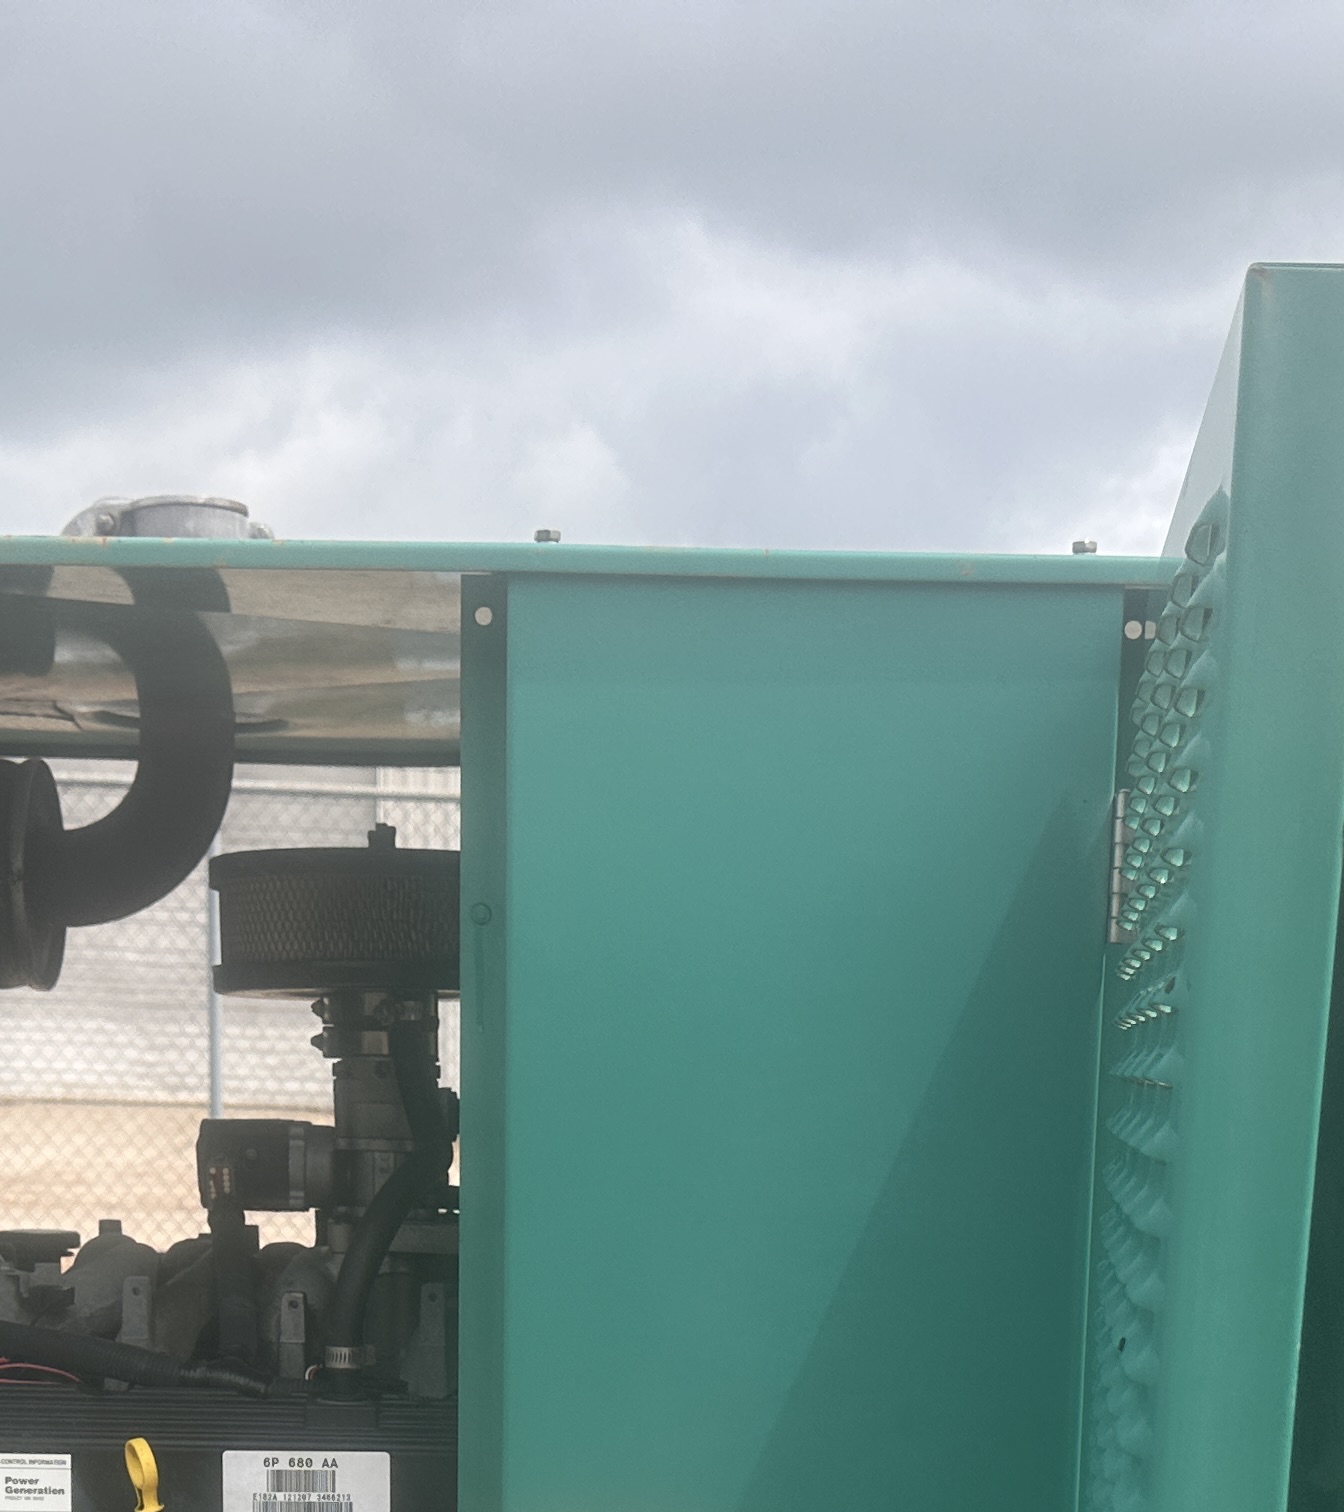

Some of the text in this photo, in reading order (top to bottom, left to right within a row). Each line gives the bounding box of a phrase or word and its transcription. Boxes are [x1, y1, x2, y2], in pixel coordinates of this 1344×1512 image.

[263, 1458, 338, 1468] 6P 680 AA
[5, 1476, 39, 1485] Power
[5, 1486, 65, 1495] Generation
